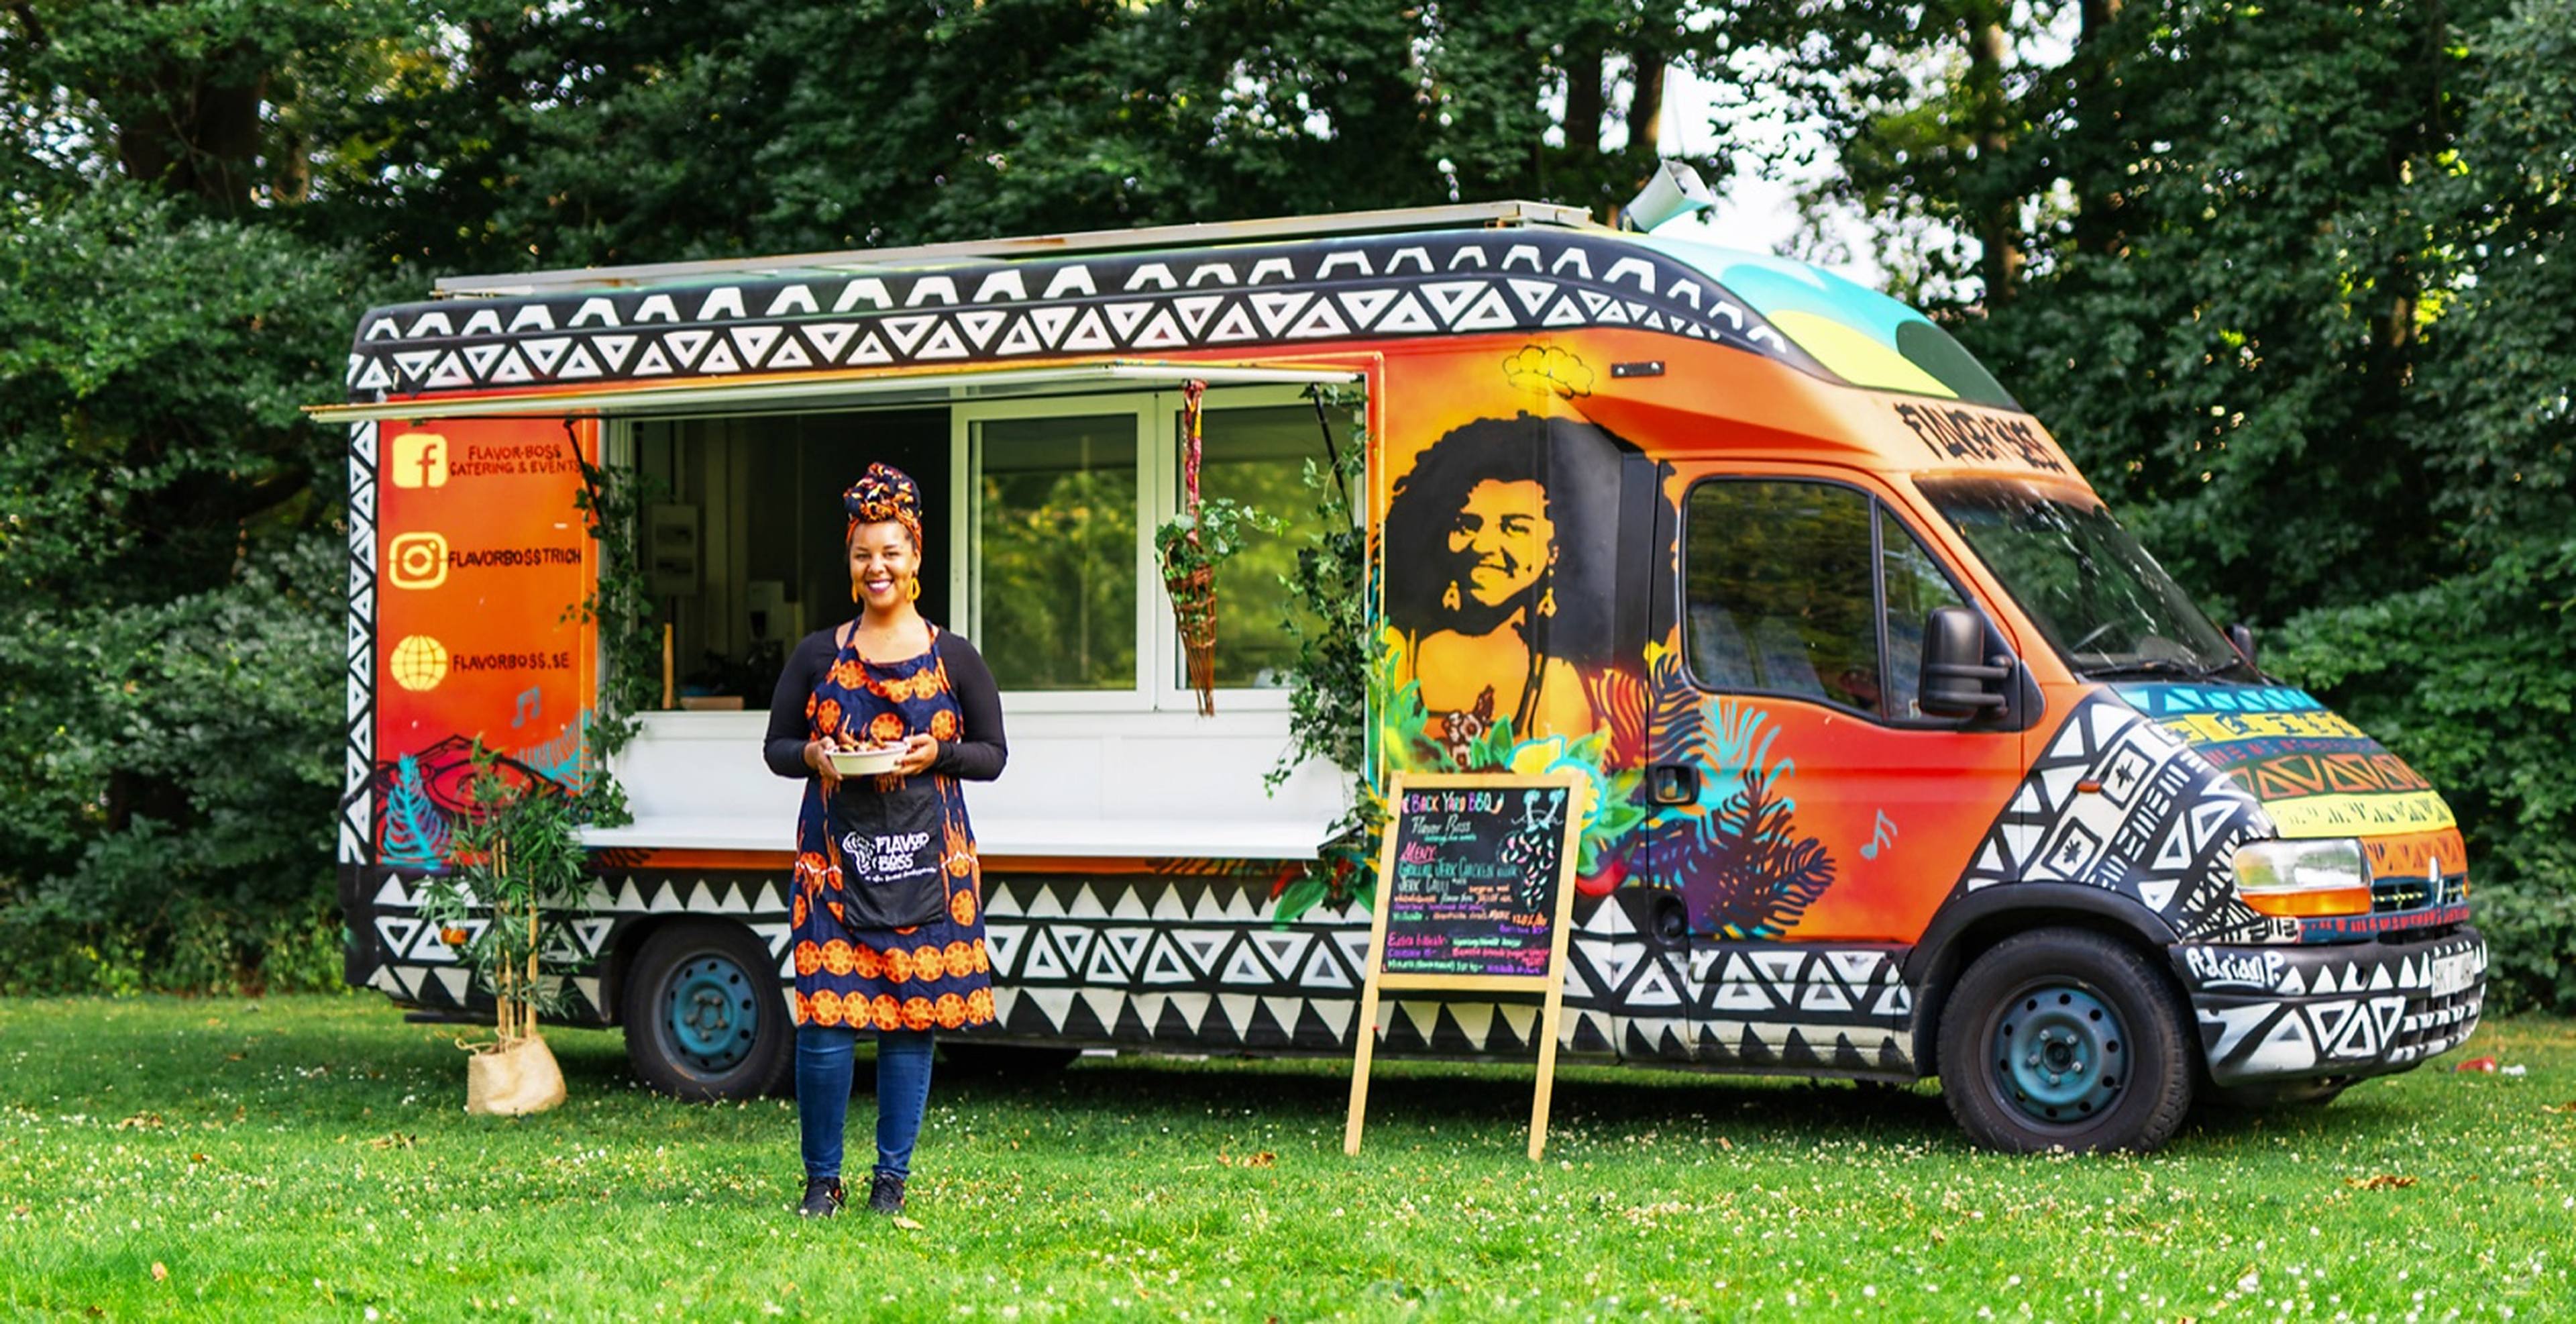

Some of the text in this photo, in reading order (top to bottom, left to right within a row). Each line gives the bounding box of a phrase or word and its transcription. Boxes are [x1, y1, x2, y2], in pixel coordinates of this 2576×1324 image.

[449, 462, 515, 477] CATERING
[519, 462, 529, 474] &
[453, 652, 570, 672] FLAVORBOSS.SE
[1411, 791, 1493, 813] BACK YARD BBQ
[875, 833, 929, 854] FLAVOR
[878, 853, 914, 872] BOSS
